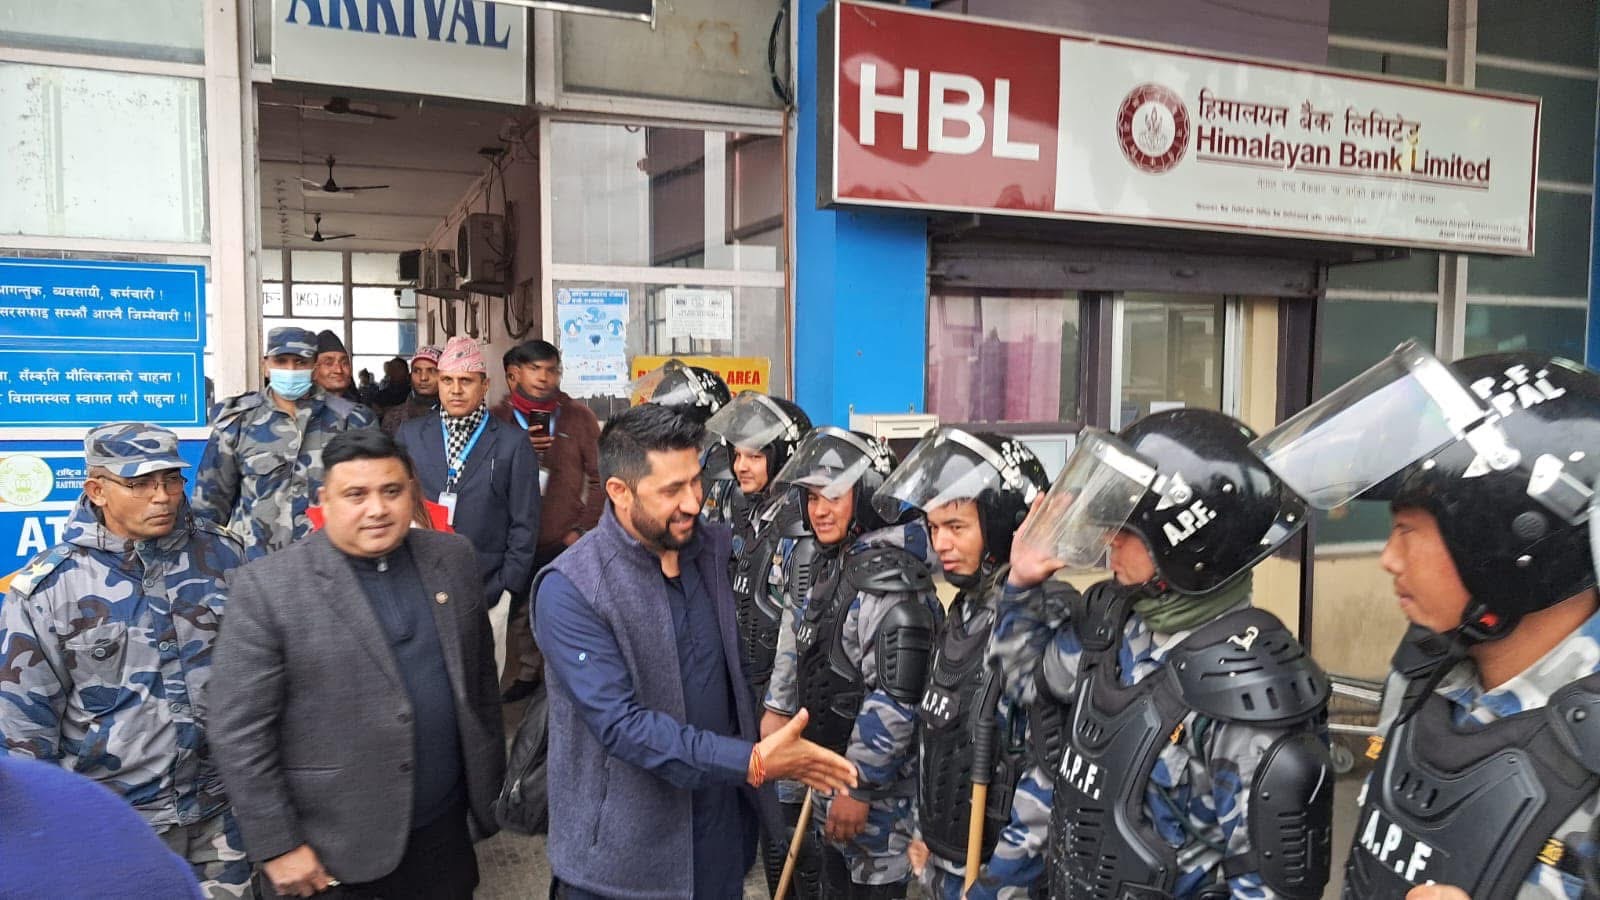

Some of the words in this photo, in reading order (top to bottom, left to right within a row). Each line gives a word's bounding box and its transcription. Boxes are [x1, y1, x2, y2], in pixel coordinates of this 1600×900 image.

[859, 63, 1040, 161] HBL
[1199, 87, 1289, 127] हिमालयन
[1197, 125, 1330, 169] Himalayan
[1339, 141, 1402, 172] Bank
[1411, 148, 1490, 182] Limited
[110, 286, 155, 301] कर्मचारी
[138, 371, 172, 385] चाहना
[727, 370, 760, 385] AREA
[8, 390, 71, 405] विमानस्थल
[76, 393, 112, 405] स्वागत
[144, 393, 175, 408] पाहुना
[1163, 499, 1217, 547] A.P.F.
[921, 690, 950, 720] A.P.F.
[1059, 746, 1100, 800] A.P.F.
